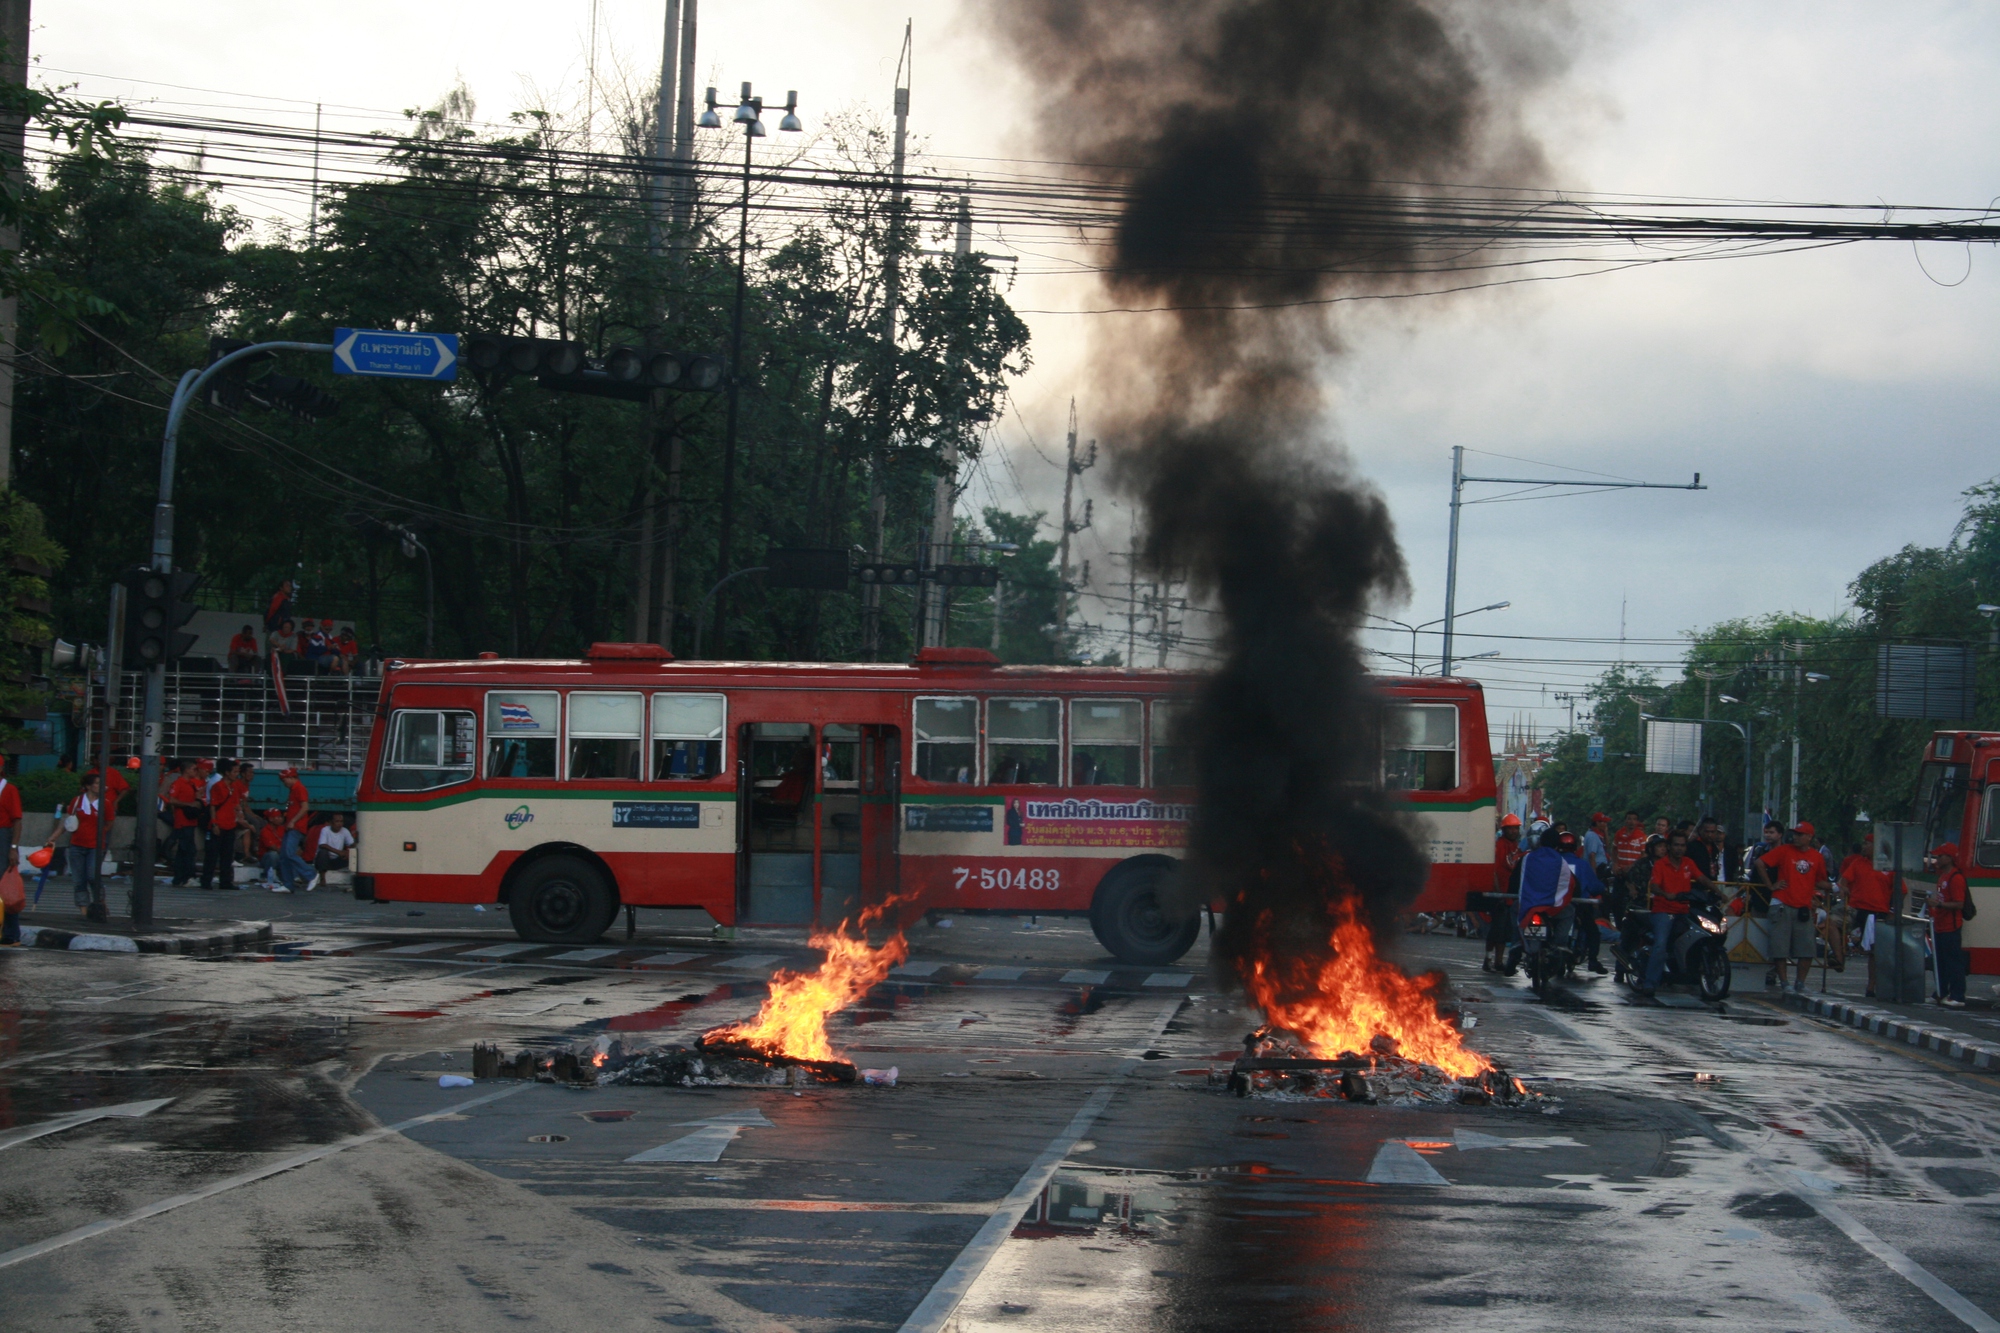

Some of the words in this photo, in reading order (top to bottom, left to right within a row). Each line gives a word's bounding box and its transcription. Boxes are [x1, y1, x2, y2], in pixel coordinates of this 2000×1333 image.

[369, 361, 392, 370] Thanon
[394, 362, 412, 371] Rama
[145, 725, 153, 737] 2
[612, 806, 632, 823] 67
[952, 866, 1060, 891] 7-50483
